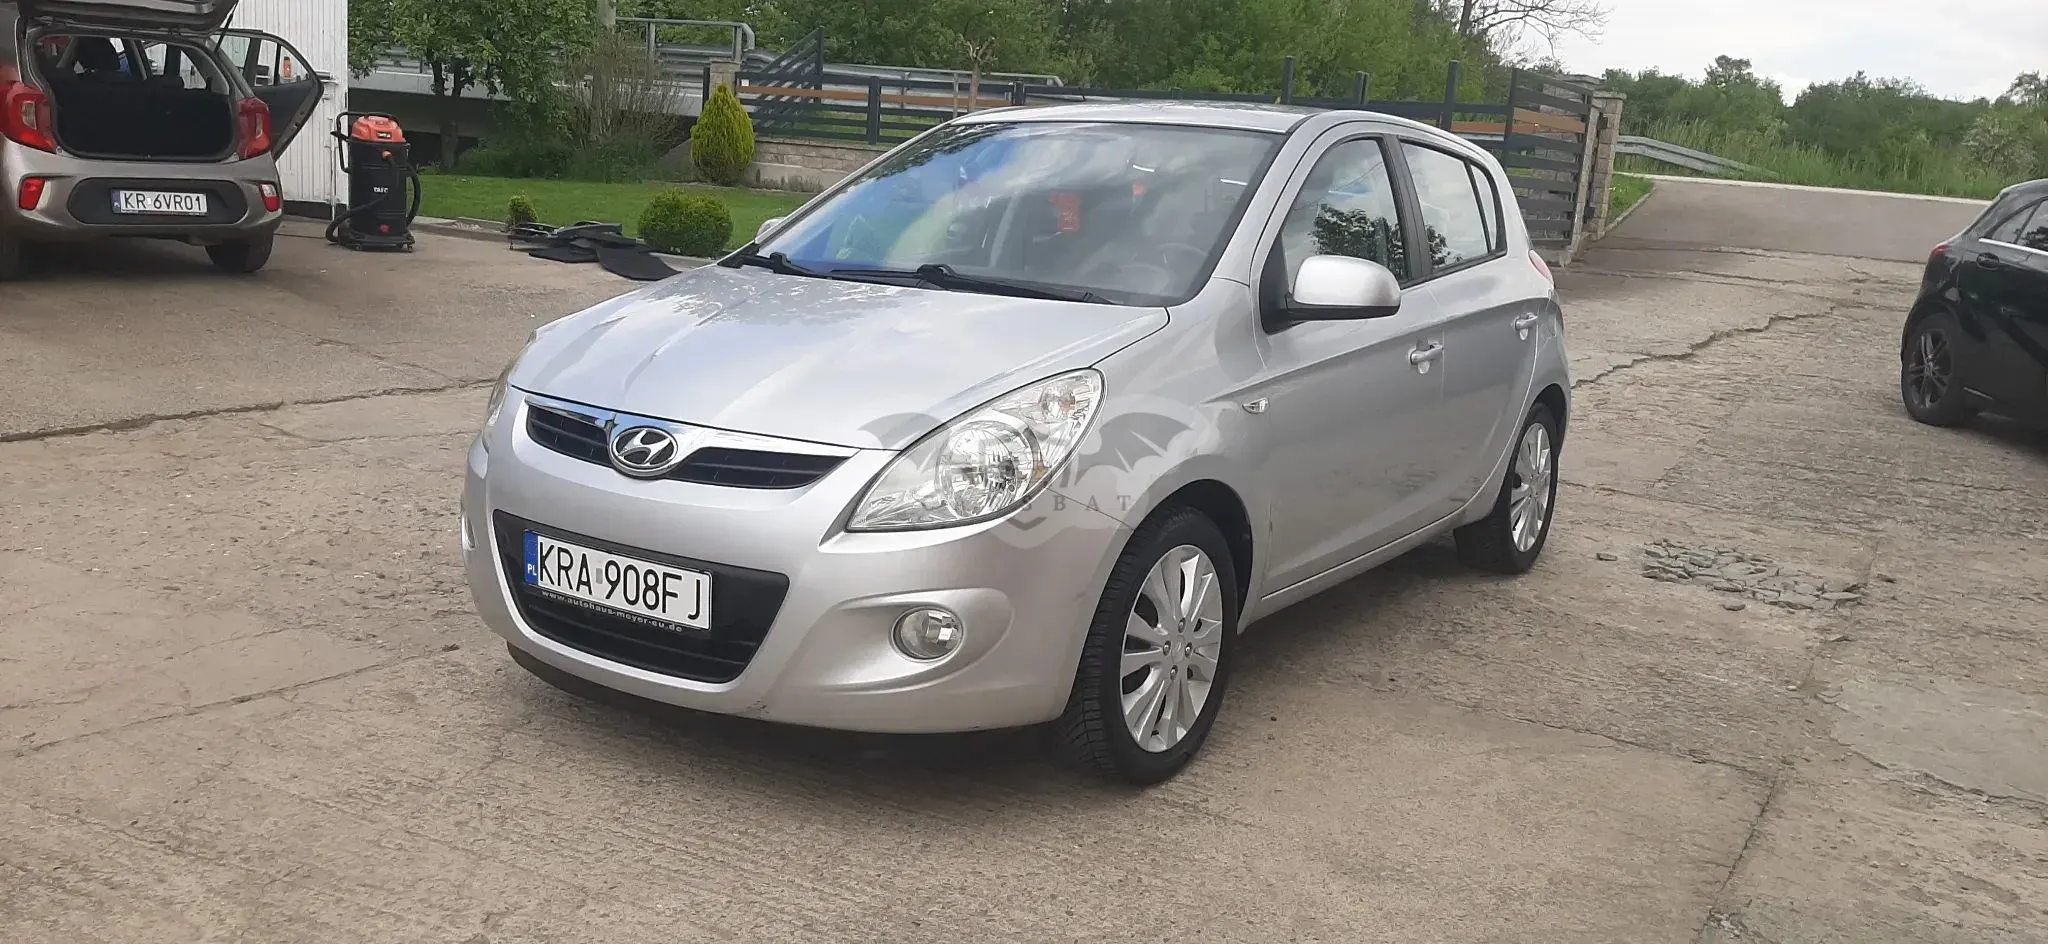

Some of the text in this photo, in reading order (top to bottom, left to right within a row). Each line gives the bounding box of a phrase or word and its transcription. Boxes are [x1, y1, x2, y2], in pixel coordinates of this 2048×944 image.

[124, 192, 202, 211] KR 6VR01
[527, 563, 537, 576] PL
[539, 541, 593, 596] KRA
